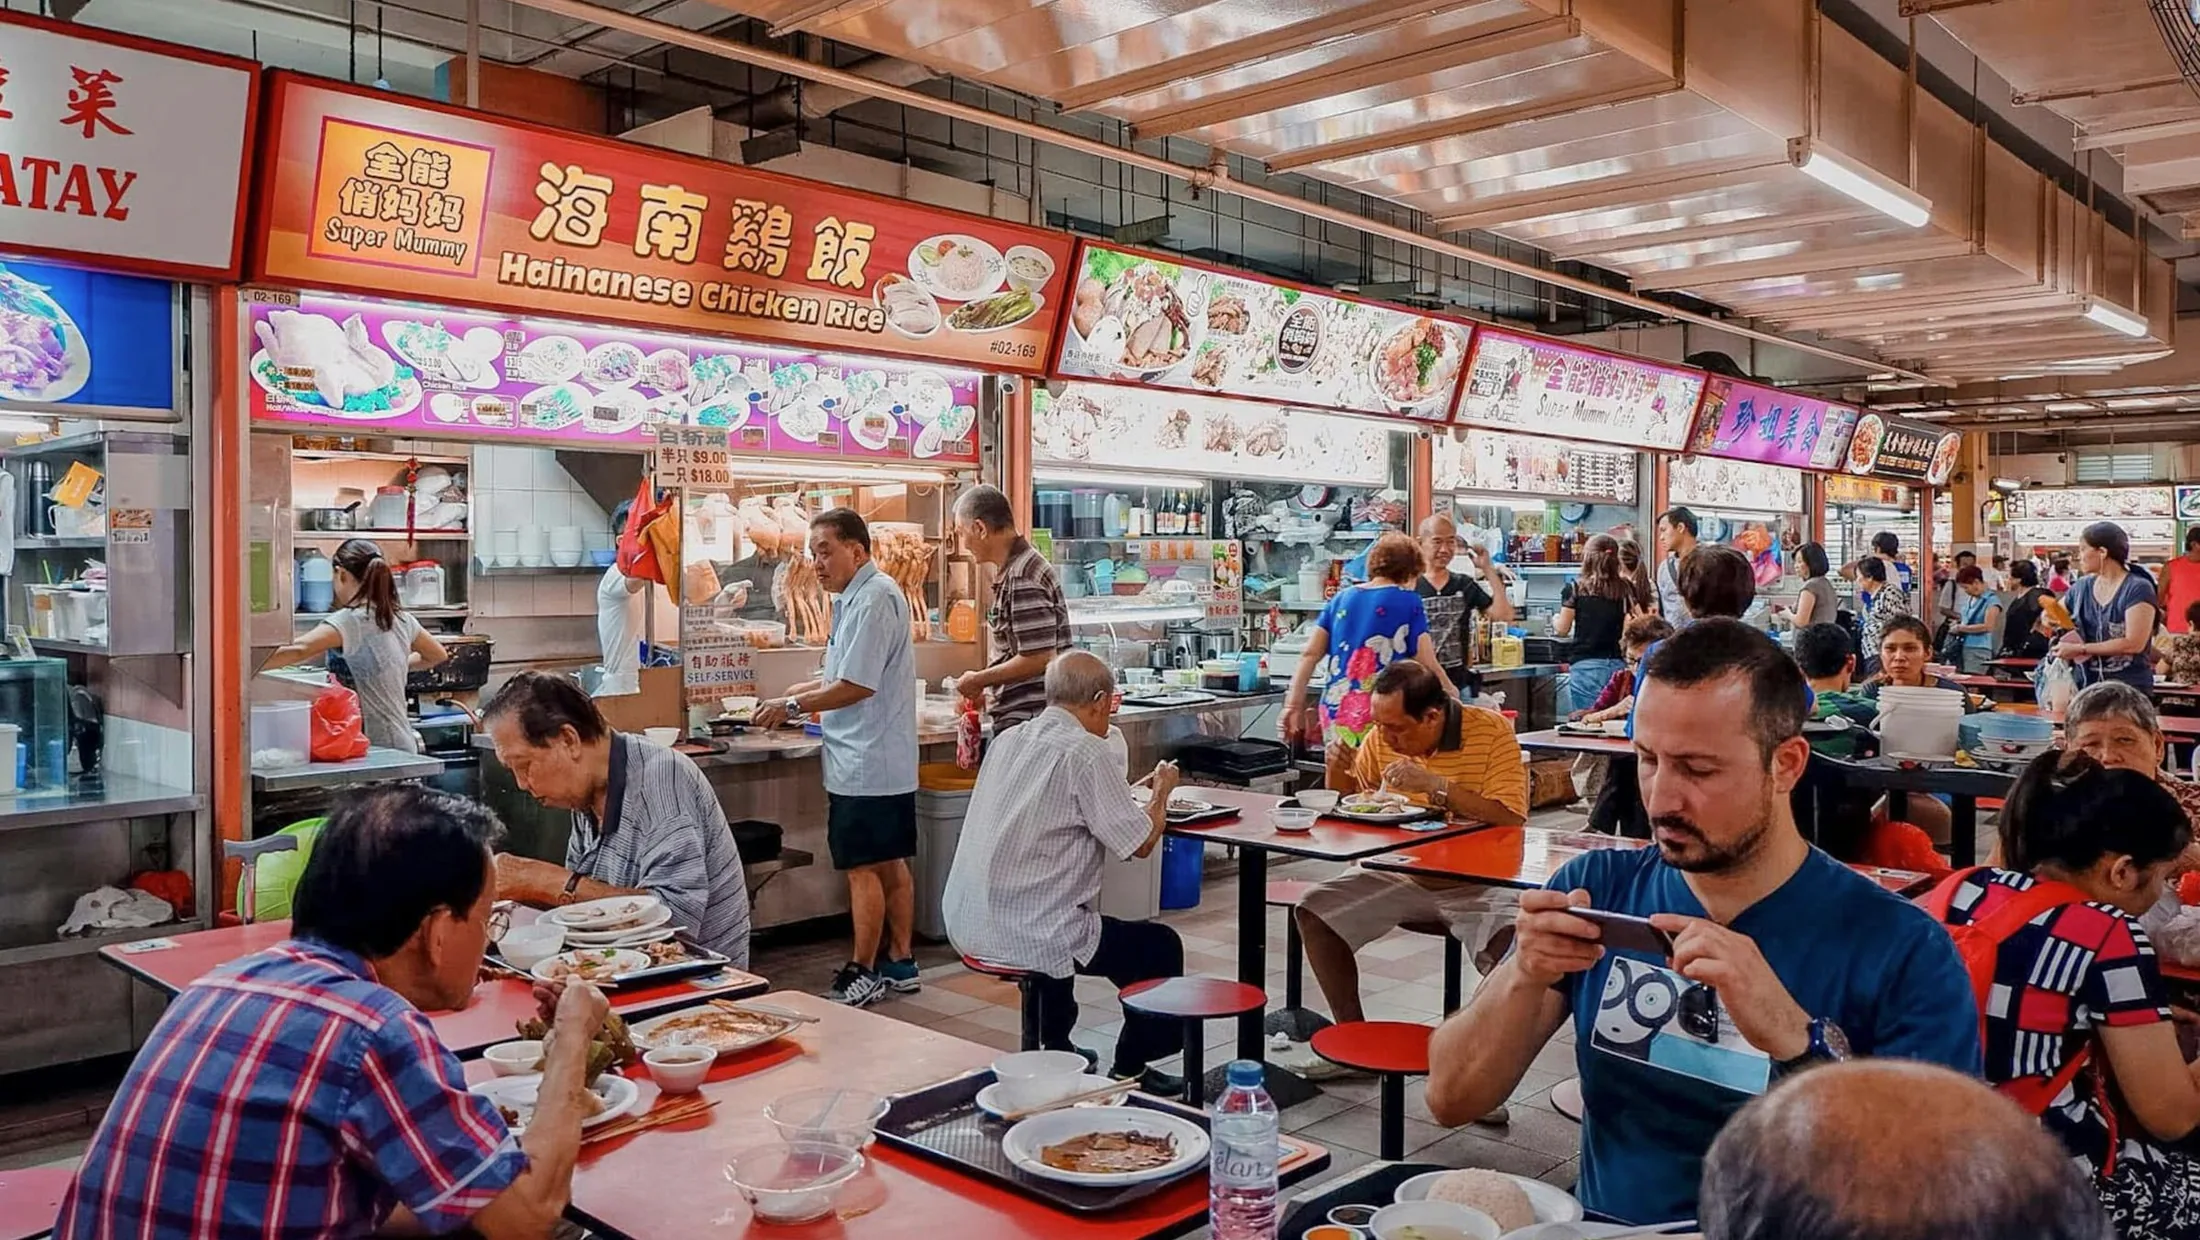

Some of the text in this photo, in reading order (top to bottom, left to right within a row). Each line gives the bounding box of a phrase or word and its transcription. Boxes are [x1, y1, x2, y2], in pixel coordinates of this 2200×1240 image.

[364, 141, 451, 189] 全能
[339, 177, 465, 232] 俏妈妈
[325, 217, 467, 266] Super Mummy
[253, 291, 291, 305] 02-169
[499, 251, 887, 333] Hainanese Chicken Rice
[990, 340, 1037, 358] #02-169
[661, 447, 727, 464] 半只 $9.00
[662, 467, 729, 483] 一只 $18.00
[688, 669, 755, 684] SELF-SERVICE
